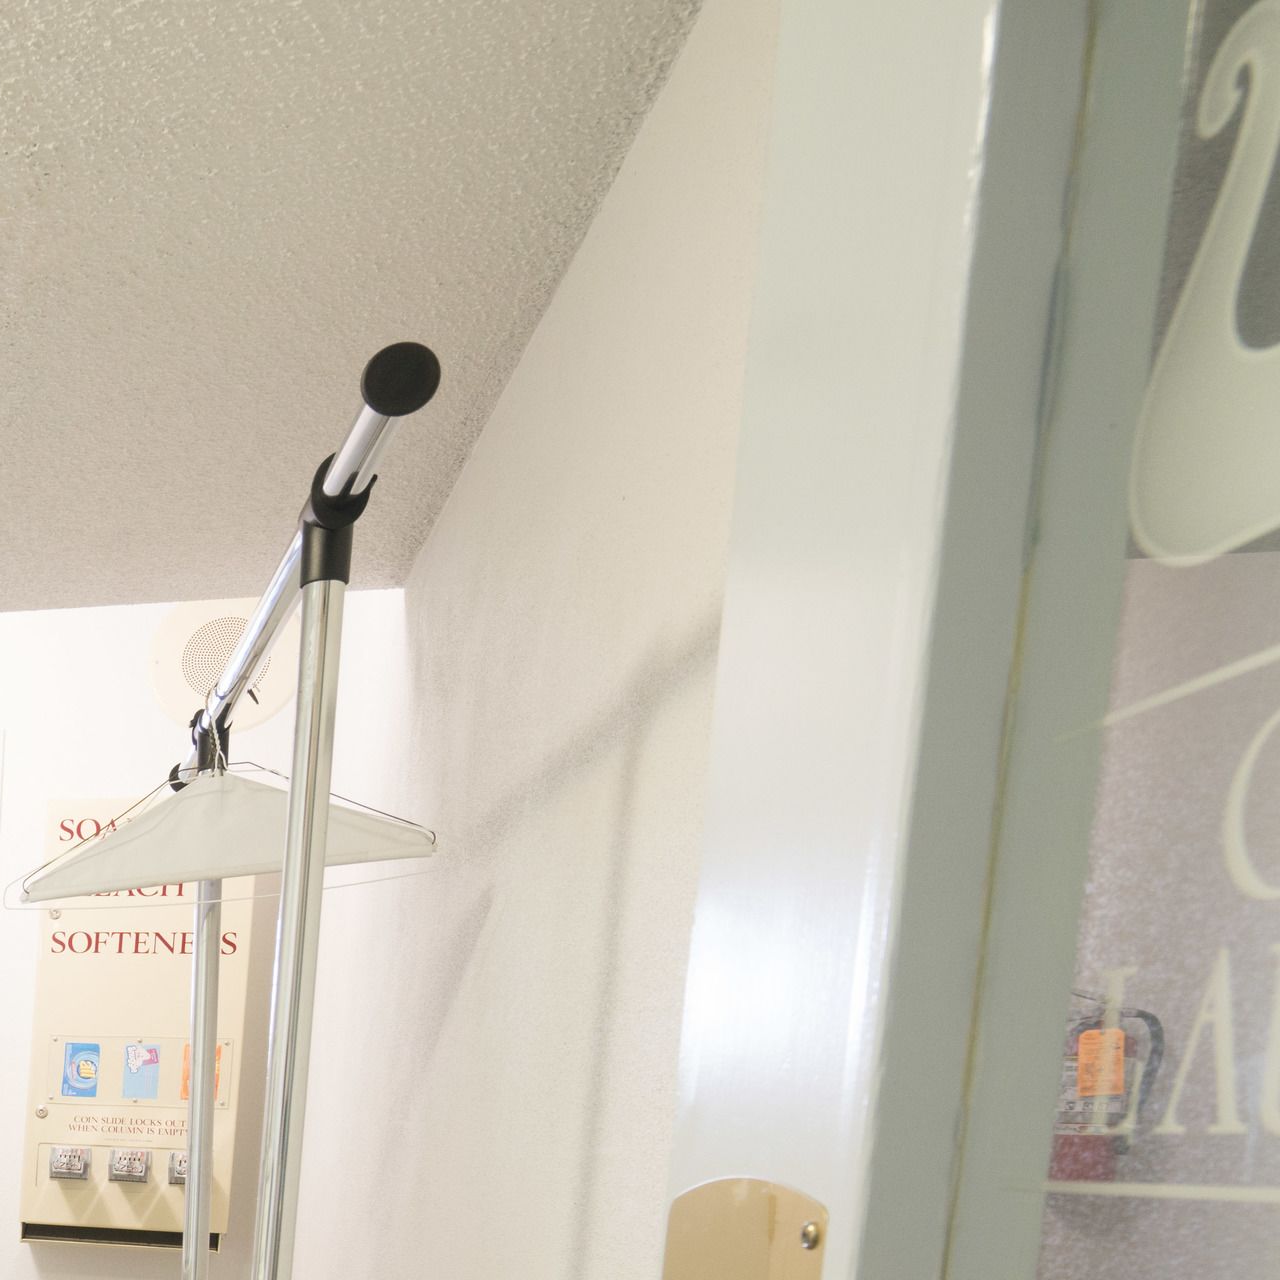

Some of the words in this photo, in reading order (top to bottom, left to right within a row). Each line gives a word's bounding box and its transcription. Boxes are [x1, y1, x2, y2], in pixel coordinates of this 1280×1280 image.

[59, 817, 132, 841] SOA
[50, 931, 238, 956] SOFTENES
[1090, 944, 1280, 1137] LA
[68, 1123, 99, 1132] WHEN
[101, 1125, 145, 1135] COLUMN
[146, 1127, 155, 1135] IS
[158, 1128, 189, 1137] EMPT
[73, 1115, 99, 1124] COIN
[101, 1116, 128, 1125] SLIDE
[130, 1118, 162, 1126] LOCKS
[165, 1119, 187, 1127] OUT
